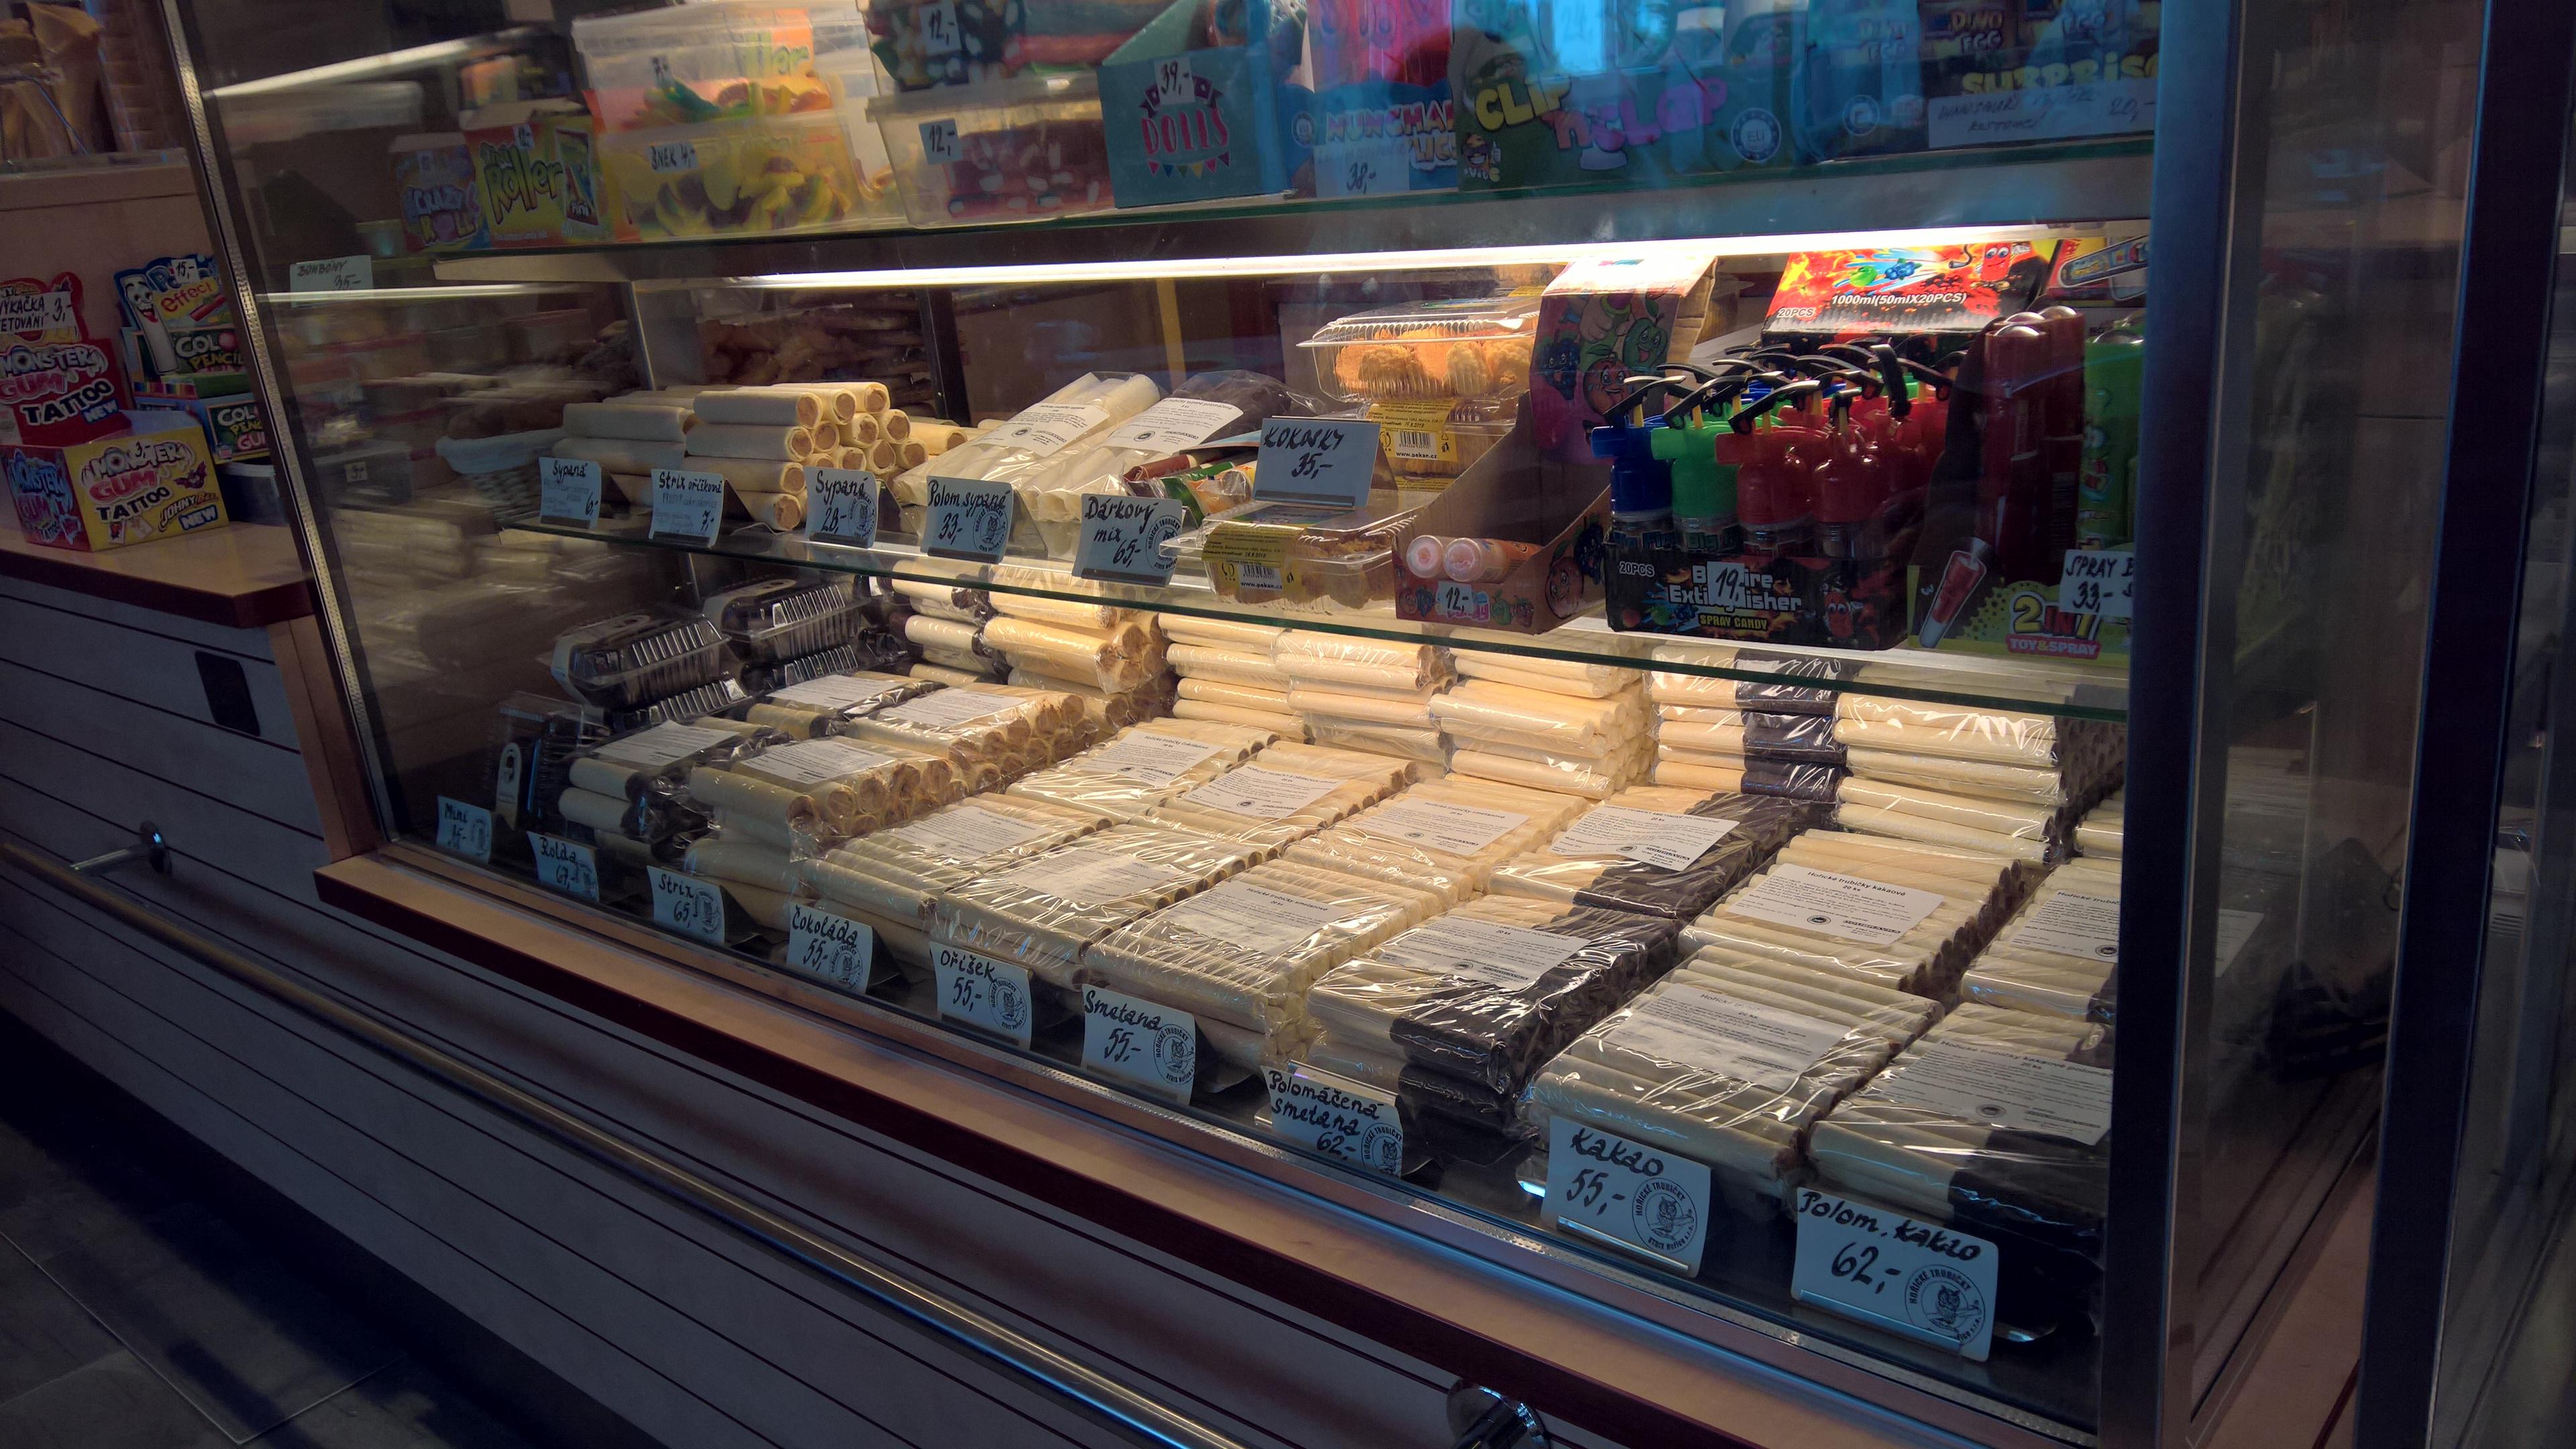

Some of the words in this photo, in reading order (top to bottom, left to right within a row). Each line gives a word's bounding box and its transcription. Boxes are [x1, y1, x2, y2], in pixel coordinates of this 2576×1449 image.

[1161, 60, 1189, 95] 39,-
[1476, 75, 1573, 131] CLIP
[929, 125, 955, 156] 12,-
[1141, 107, 1229, 156] DOLLS
[1776, 307, 1815, 319] 20PCS
[21, 380, 113, 425] TATTOO
[1291, 451, 1334, 480] 35,-
[89, 469, 159, 500] GUM
[96, 486, 171, 521] TATTOO
[180, 504, 219, 530] NEW
[820, 506, 847, 535] 28,-
[1084, 495, 1159, 535] Dárkový
[938, 512, 963, 546] 33,-
[1093, 525, 1123, 543] mix
[1112, 539, 1142, 568] 65,-
[1618, 561, 1655, 577] 20PCS
[2065, 555, 2119, 578] SPRAY
[1446, 586, 1469, 612] 12,-
[1699, 612, 1731, 628] SPRAY
[1733, 615, 1768, 631] CANDY
[658, 873, 694, 899] Strix
[1807, 871, 1839, 881] Hořické
[1838, 875, 1872, 890] trubičky
[1871, 883, 1907, 897] kakaové
[792, 904, 859, 949] Čokoláda
[802, 938, 829, 972] 55,-
[940, 949, 997, 983] Oříšek
[952, 977, 982, 1012] 55,-
[1083, 989, 1162, 1032] Smetana
[1104, 1027, 1142, 1063] 55,-
[1268, 1069, 1385, 1121] Polomáčená
[1271, 1098, 1361, 1137] smetana
[1566, 1168, 1626, 1216] 55,-
[1635, 1183, 1653, 1216] HOŘICKÉ
[1652, 1181, 1686, 1201] TRUBIČKY
[1831, 1241, 1902, 1295] 62,-
[1909, 1270, 1931, 1305] HOŘICKÉ
[1929, 1269, 1972, 1291] TRUBIČKY
